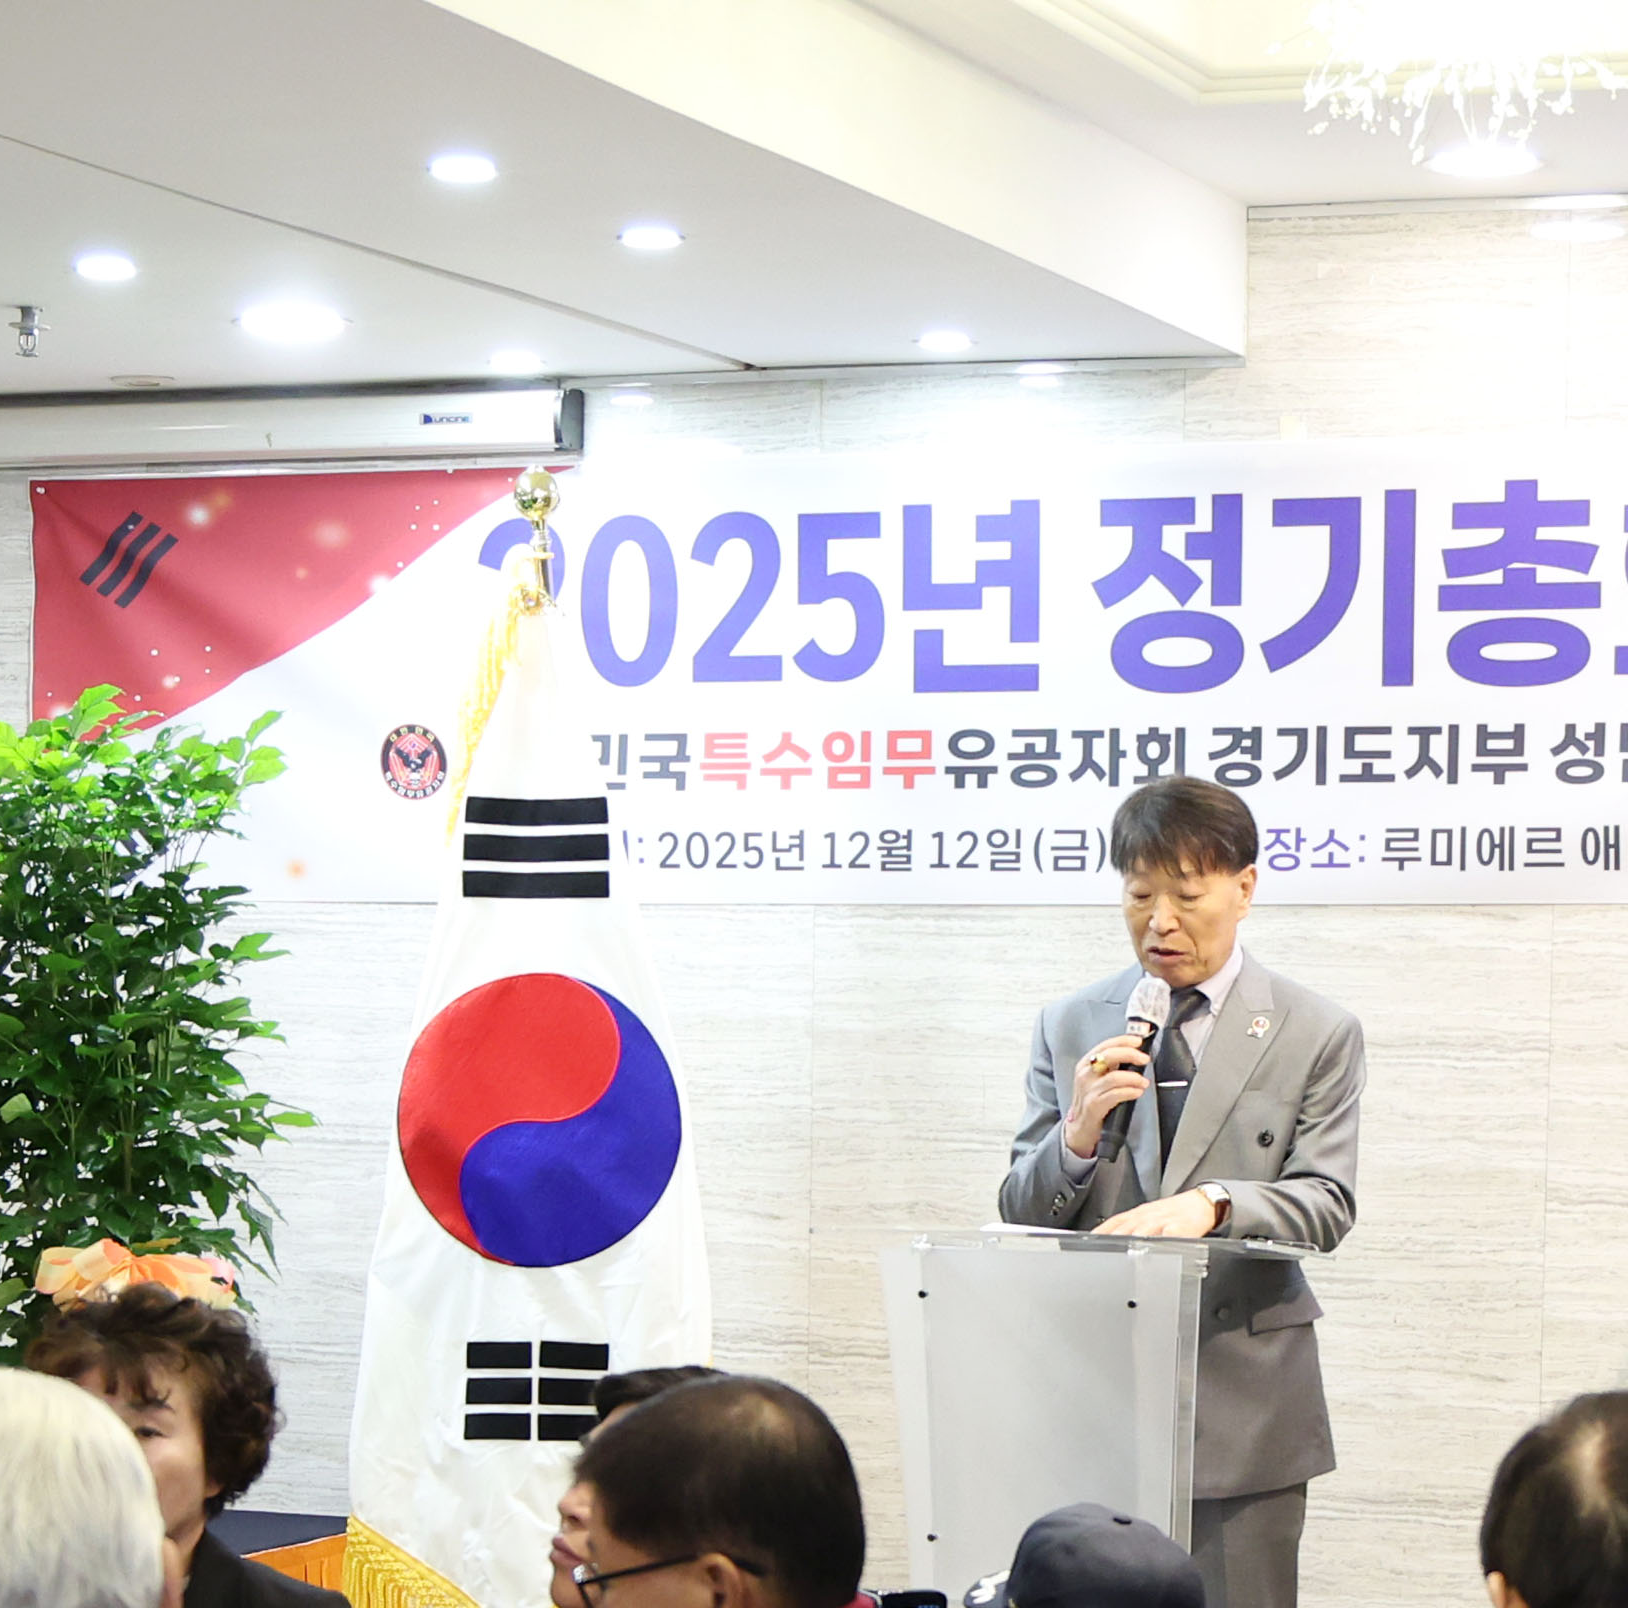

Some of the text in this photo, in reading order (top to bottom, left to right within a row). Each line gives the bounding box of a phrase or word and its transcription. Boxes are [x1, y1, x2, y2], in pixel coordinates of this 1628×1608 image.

[1207, 724, 1530, 787] 경기도지부
[658, 829, 806, 872] 2025년
[822, 828, 913, 873] 12월
[930, 827, 1107, 874] 12일(금)
[1264, 827, 1367, 873] 장소:
[1381, 826, 1567, 873] 루미에르
